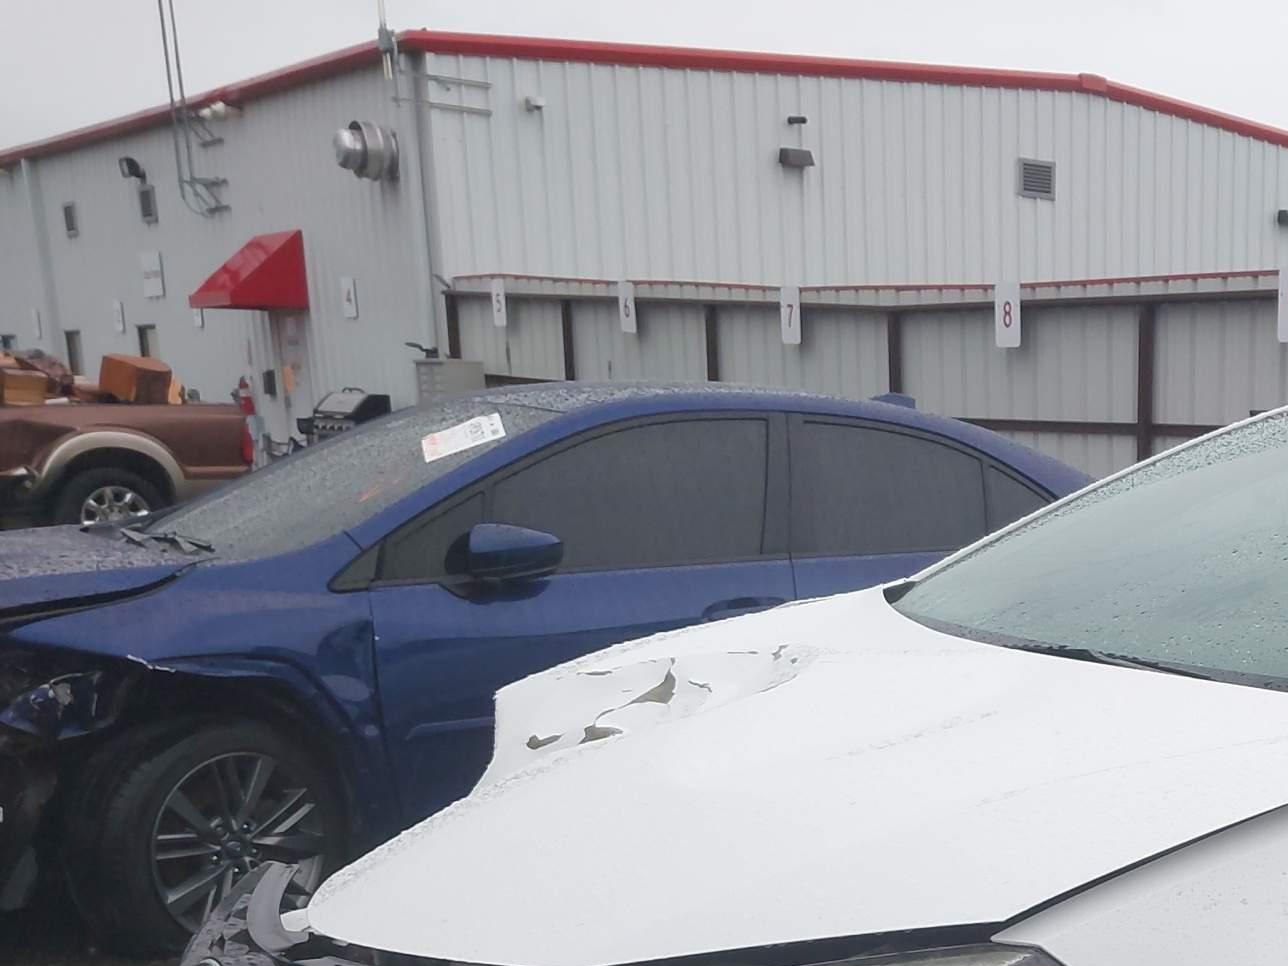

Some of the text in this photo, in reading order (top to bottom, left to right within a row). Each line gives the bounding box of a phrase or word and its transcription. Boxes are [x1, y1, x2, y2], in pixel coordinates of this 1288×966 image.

[345, 287, 353, 305] 4
[495, 293, 502, 313] 5
[623, 297, 631, 318] 6
[786, 304, 794, 329] 7
[1002, 300, 1013, 329] 8
